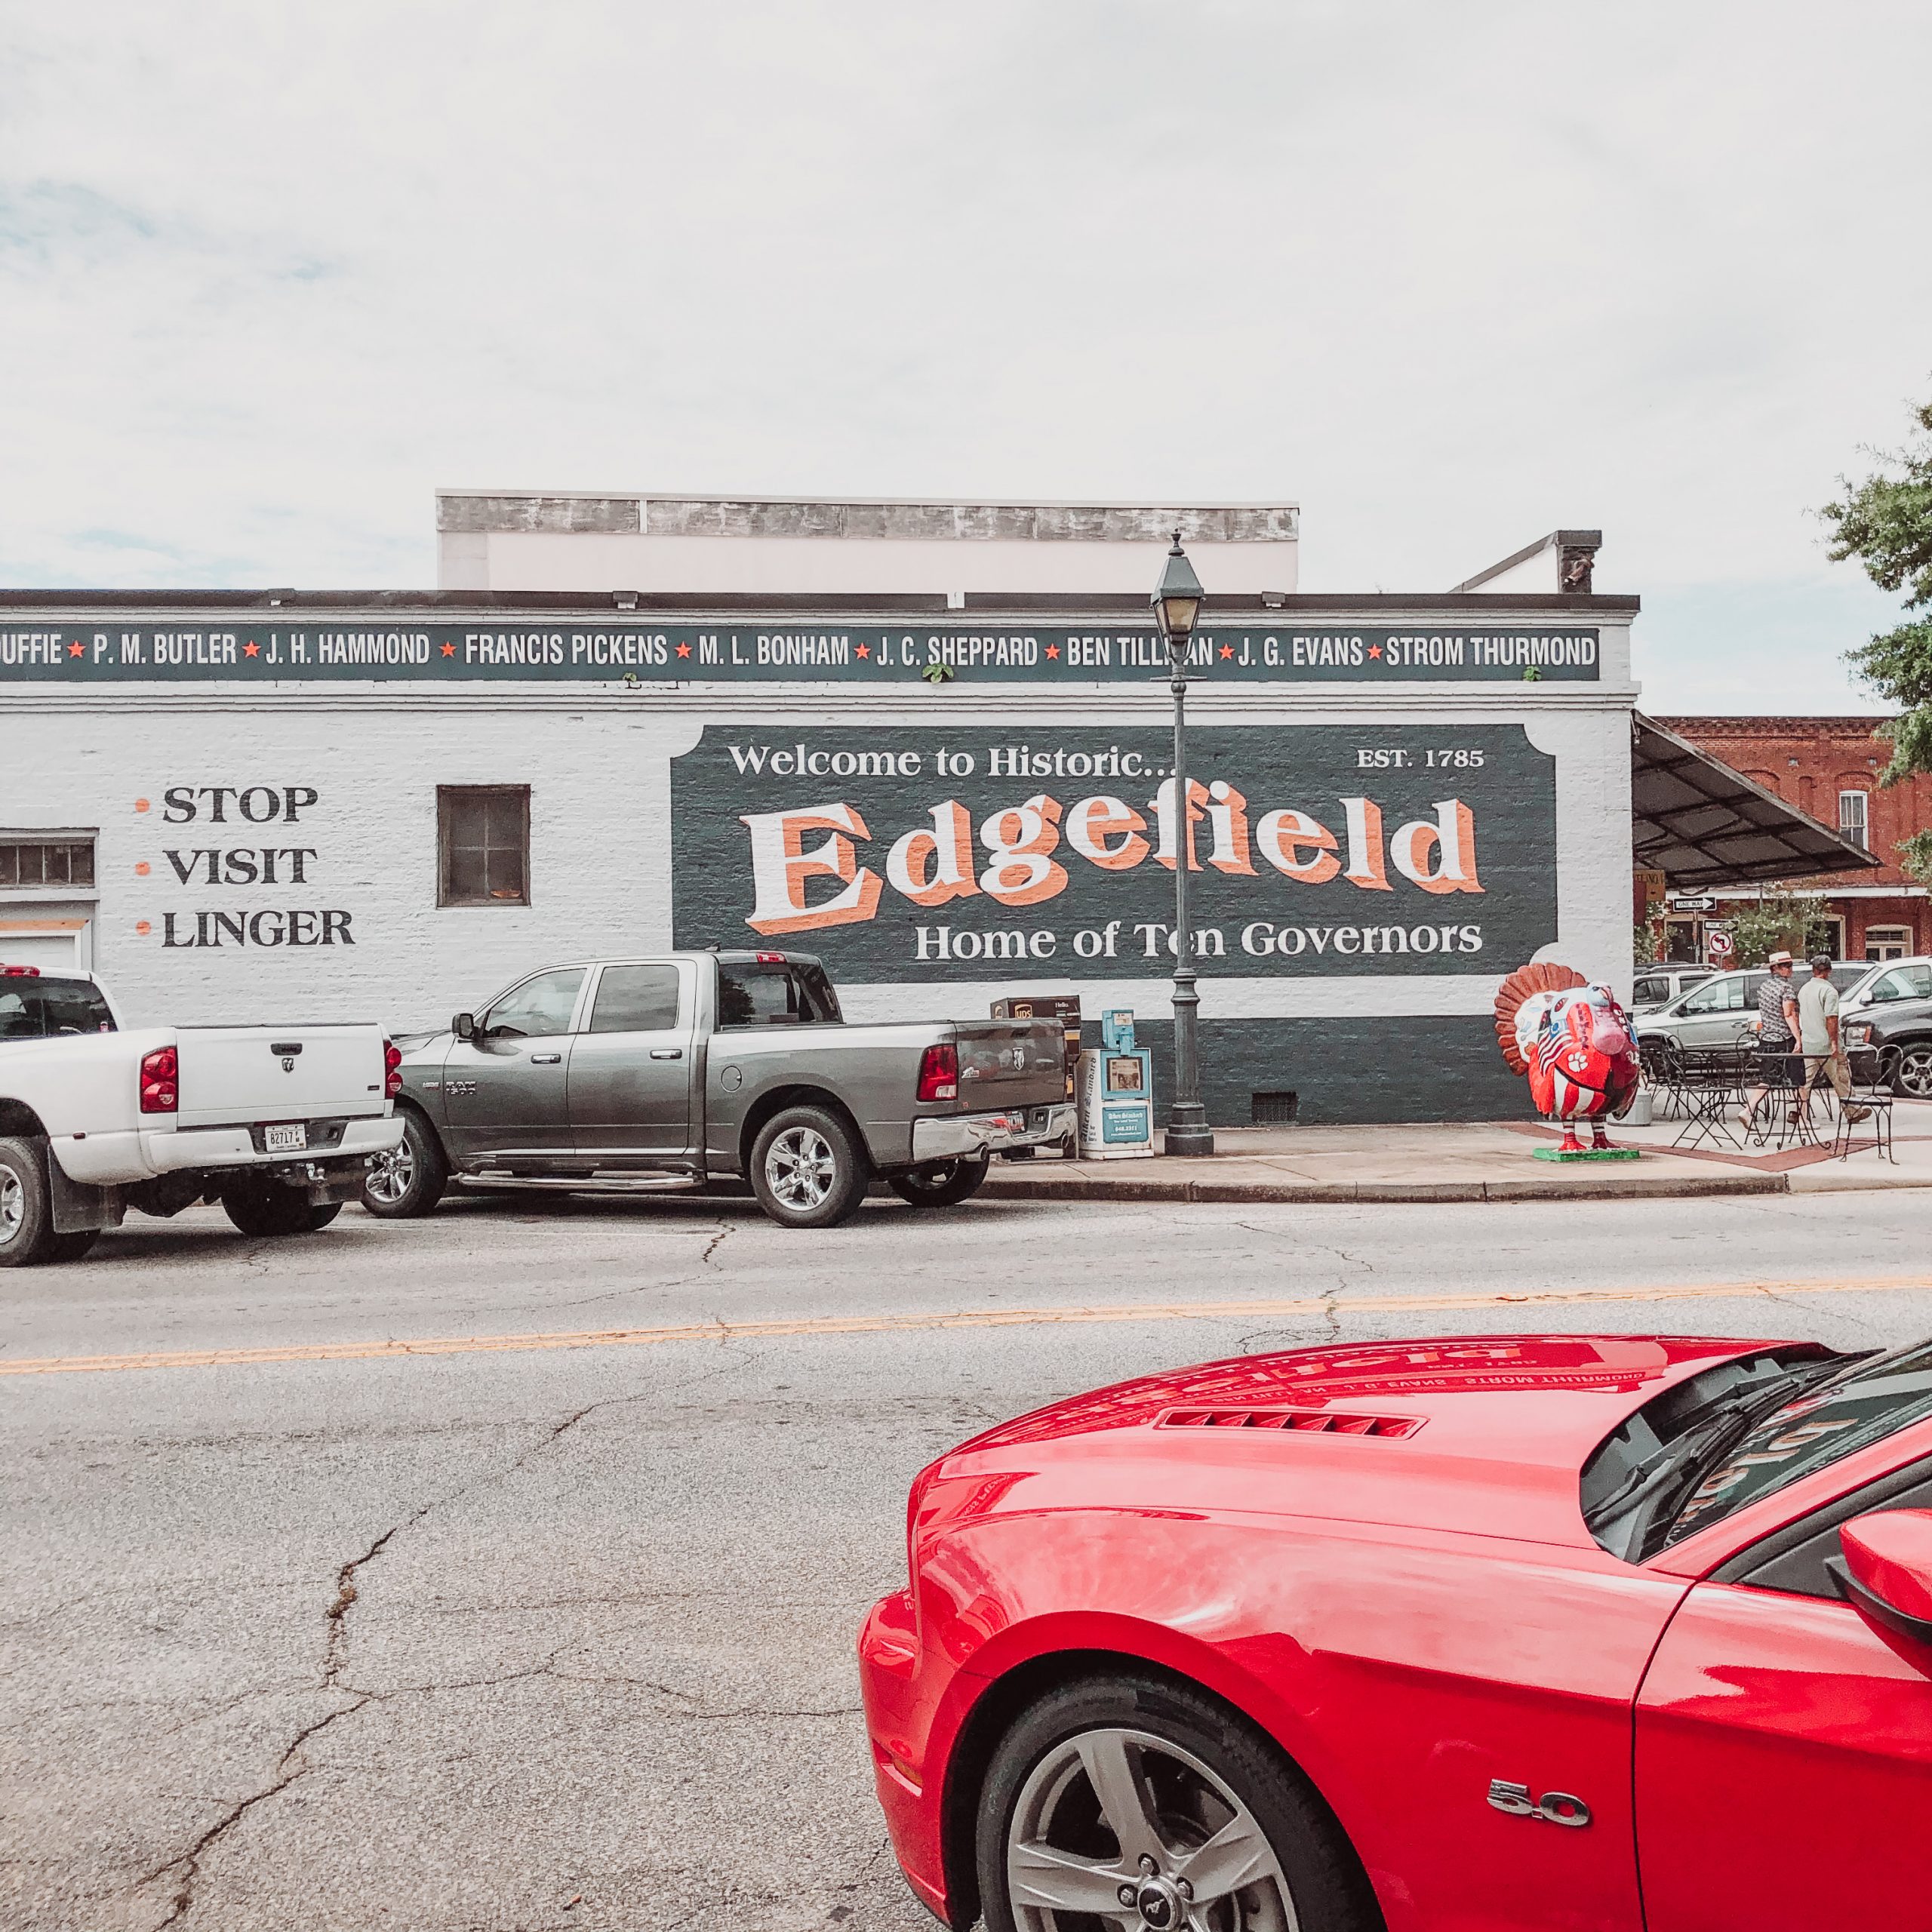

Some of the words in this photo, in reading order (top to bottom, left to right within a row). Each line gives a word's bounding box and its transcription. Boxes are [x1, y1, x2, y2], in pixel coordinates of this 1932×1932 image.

[0, 634, 62, 664] UFFIE
[94, 635, 114, 664] P.
[122, 634, 146, 664] M.
[155, 634, 237, 664] BUTLER
[266, 634, 283, 664] J.
[291, 634, 312, 664] H.
[319, 634, 429, 664] HAMMOND
[466, 635, 564, 664] FRANCIS
[572, 635, 668, 665] PICKENS
[700, 636, 724, 664] M.
[732, 636, 749, 665] L.
[758, 635, 849, 665] BONHAM
[878, 637, 894, 666] J.
[902, 637, 921, 666] C.
[928, 636, 1038, 666] SHEPPARD
[1068, 637, 1110, 666] BEN
[1238, 637, 1256, 666] J.
[1264, 637, 1284, 666] G.
[1293, 636, 1364, 666] EVANS
[1386, 636, 1463, 666] STROM
[1470, 637, 1595, 666] THURMOND
[728, 744, 921, 776] Welcome
[936, 746, 975, 777] to
[987, 745, 1176, 777] Historic...
[1358, 749, 1413, 768] EST.
[1426, 749, 1484, 768] 1785
[162, 786, 318, 823] STOP
[162, 848, 318, 884] VISIT
[739, 777, 1485, 936] Edgefield
[162, 910, 356, 947] LINGER
[915, 926, 1057, 959] Home
[1073, 921, 1121, 958] of
[1241, 922, 1483, 955] Governors
[1487, 1778, 1590, 1826] 5.0
